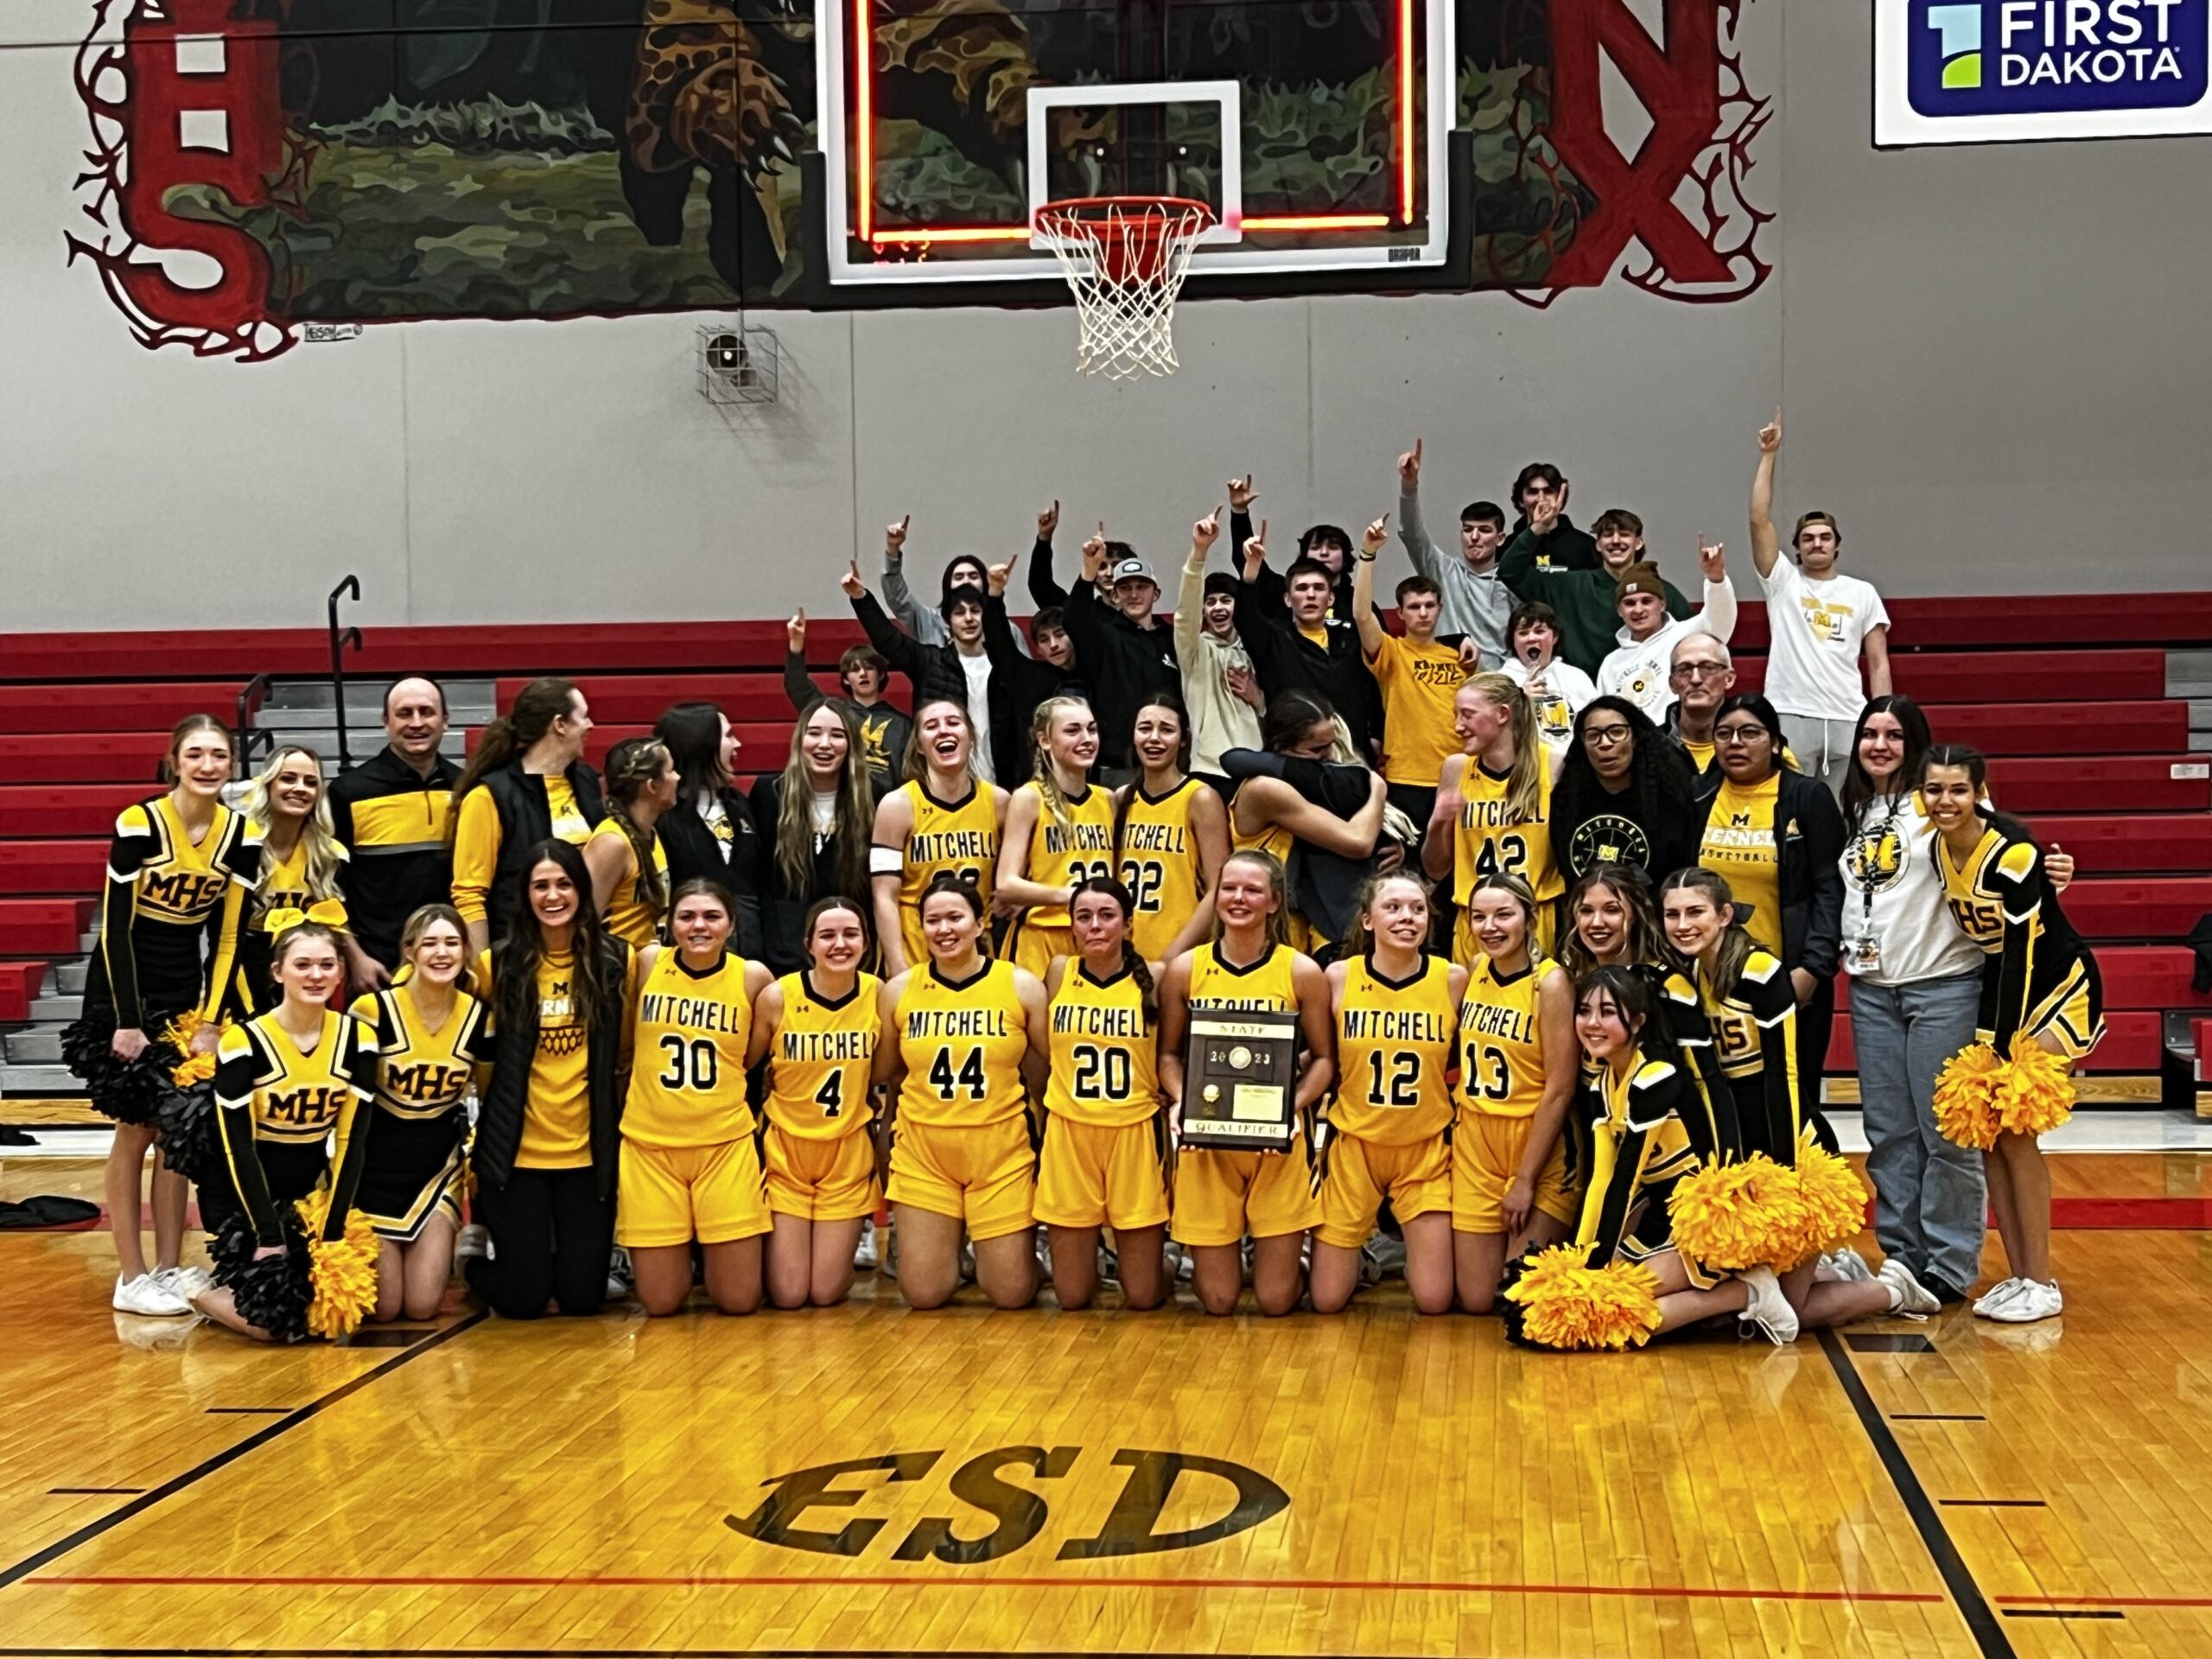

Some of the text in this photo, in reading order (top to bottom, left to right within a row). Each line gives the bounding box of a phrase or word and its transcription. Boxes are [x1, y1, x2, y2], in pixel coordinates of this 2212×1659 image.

[2001, 0, 2183, 48] FIRST
[2001, 48, 2183, 87] DAKOTA
[1046, 823, 1113, 854] MCHEL
[1125, 823, 1186, 854] TCHELL
[1475, 835, 1528, 880] 42
[143, 870, 225, 909] MHS
[1948, 897, 2003, 935] HS
[641, 994, 740, 1035] MITCHELL
[907, 1009, 1008, 1039] MITCHELL
[1219, 1024, 1267, 1035] STATE
[1344, 1009, 1446, 1043] MITCHELL
[1711, 1015, 1748, 1057] HS
[388, 1063, 467, 1101] MHS
[659, 1034, 717, 1090] 30
[929, 1046, 986, 1100] 44
[1072, 1045, 1132, 1100] 20
[1368, 1049, 1421, 1107] 12
[1465, 1042, 1510, 1100] 13
[265, 1087, 347, 1125] MHS
[815, 1069, 842, 1118] 4
[1195, 1122, 1279, 1136] QUALIFIER
[721, 1445, 1293, 1566] ESD
